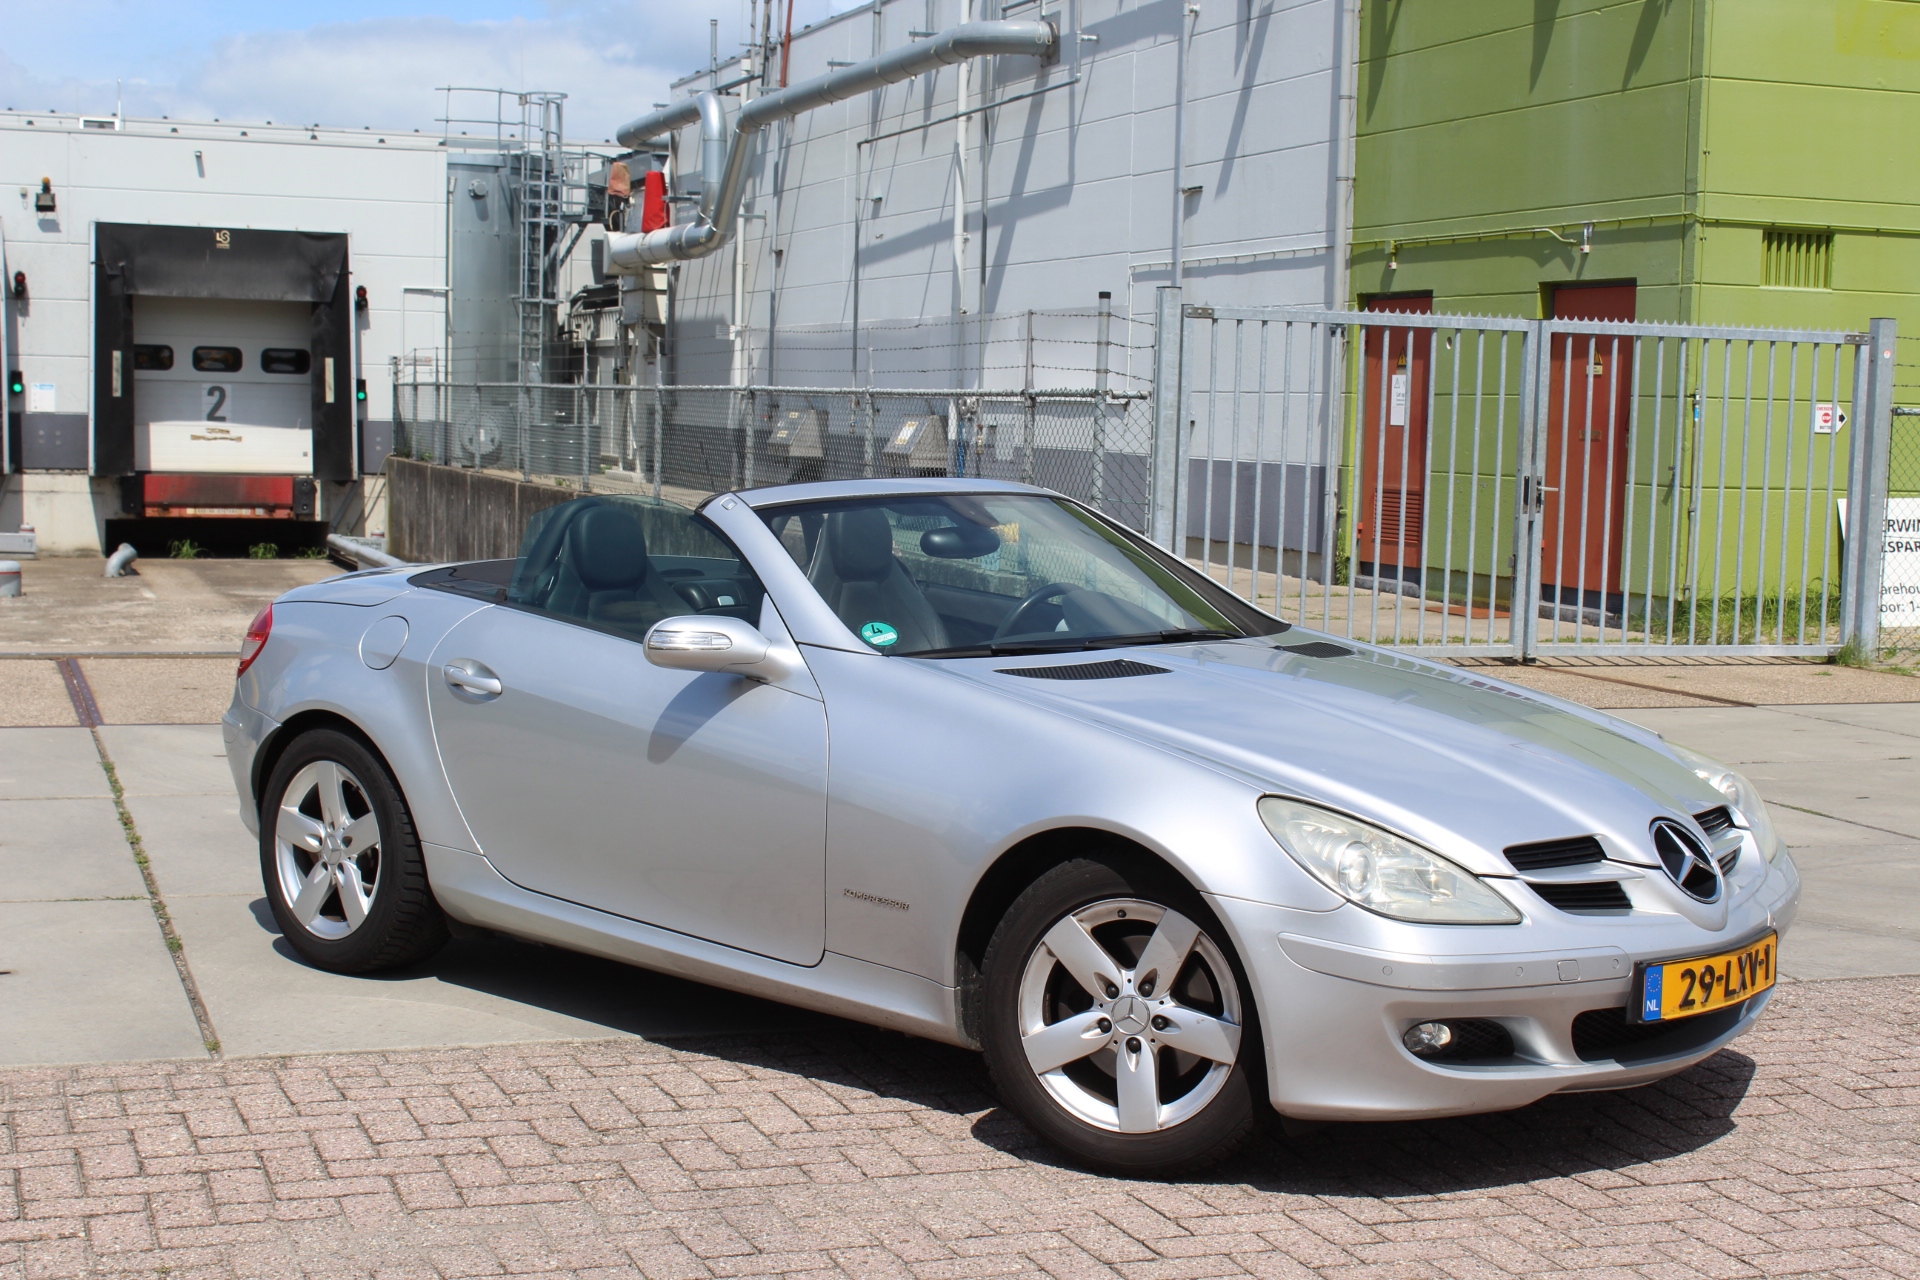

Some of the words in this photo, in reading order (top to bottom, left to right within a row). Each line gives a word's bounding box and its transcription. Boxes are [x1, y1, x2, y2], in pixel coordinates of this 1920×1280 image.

[206, 385, 227, 422] 2
[870, 623, 883, 635] 4
[843, 888, 910, 911] KOMPRESSOR
[1678, 943, 1772, 1010] 29-LXV-1
[1645, 999, 1660, 1012] NL
